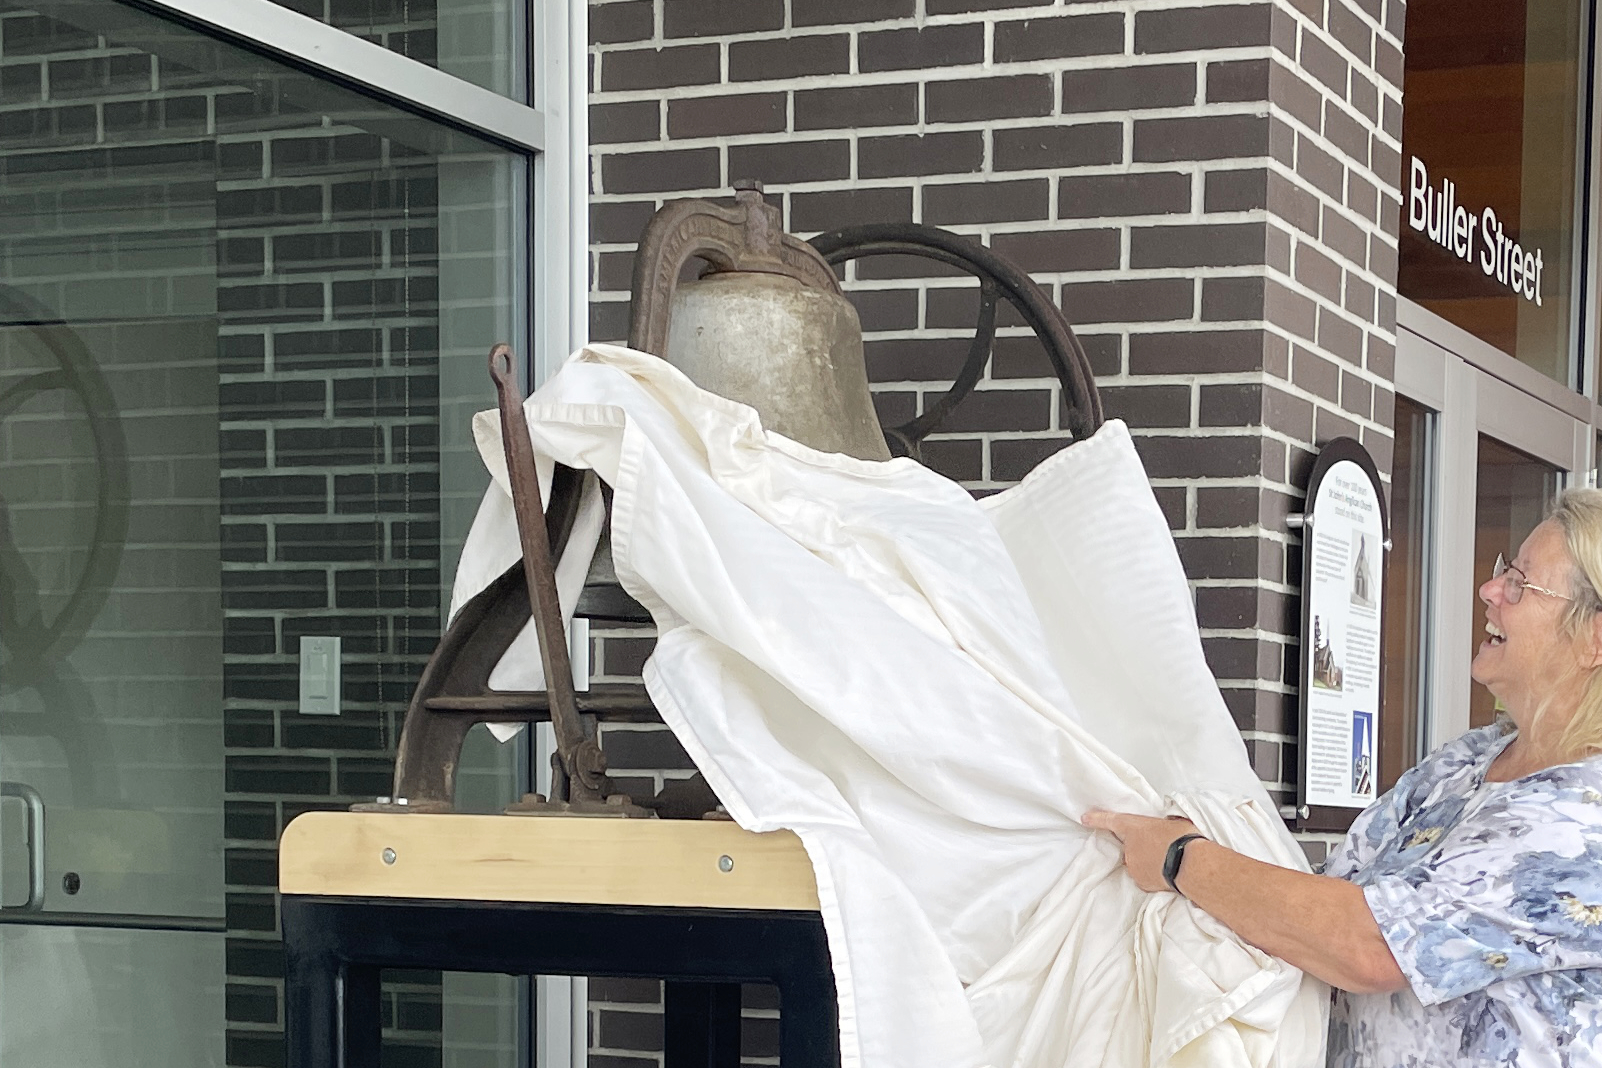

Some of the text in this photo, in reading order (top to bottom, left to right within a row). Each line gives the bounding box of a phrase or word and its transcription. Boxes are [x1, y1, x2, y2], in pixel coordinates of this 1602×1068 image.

[1409, 155, 1544, 307] Buller Street
[1345, 494, 1360, 507] Anglican
[1360, 499, 1373, 512] Church
